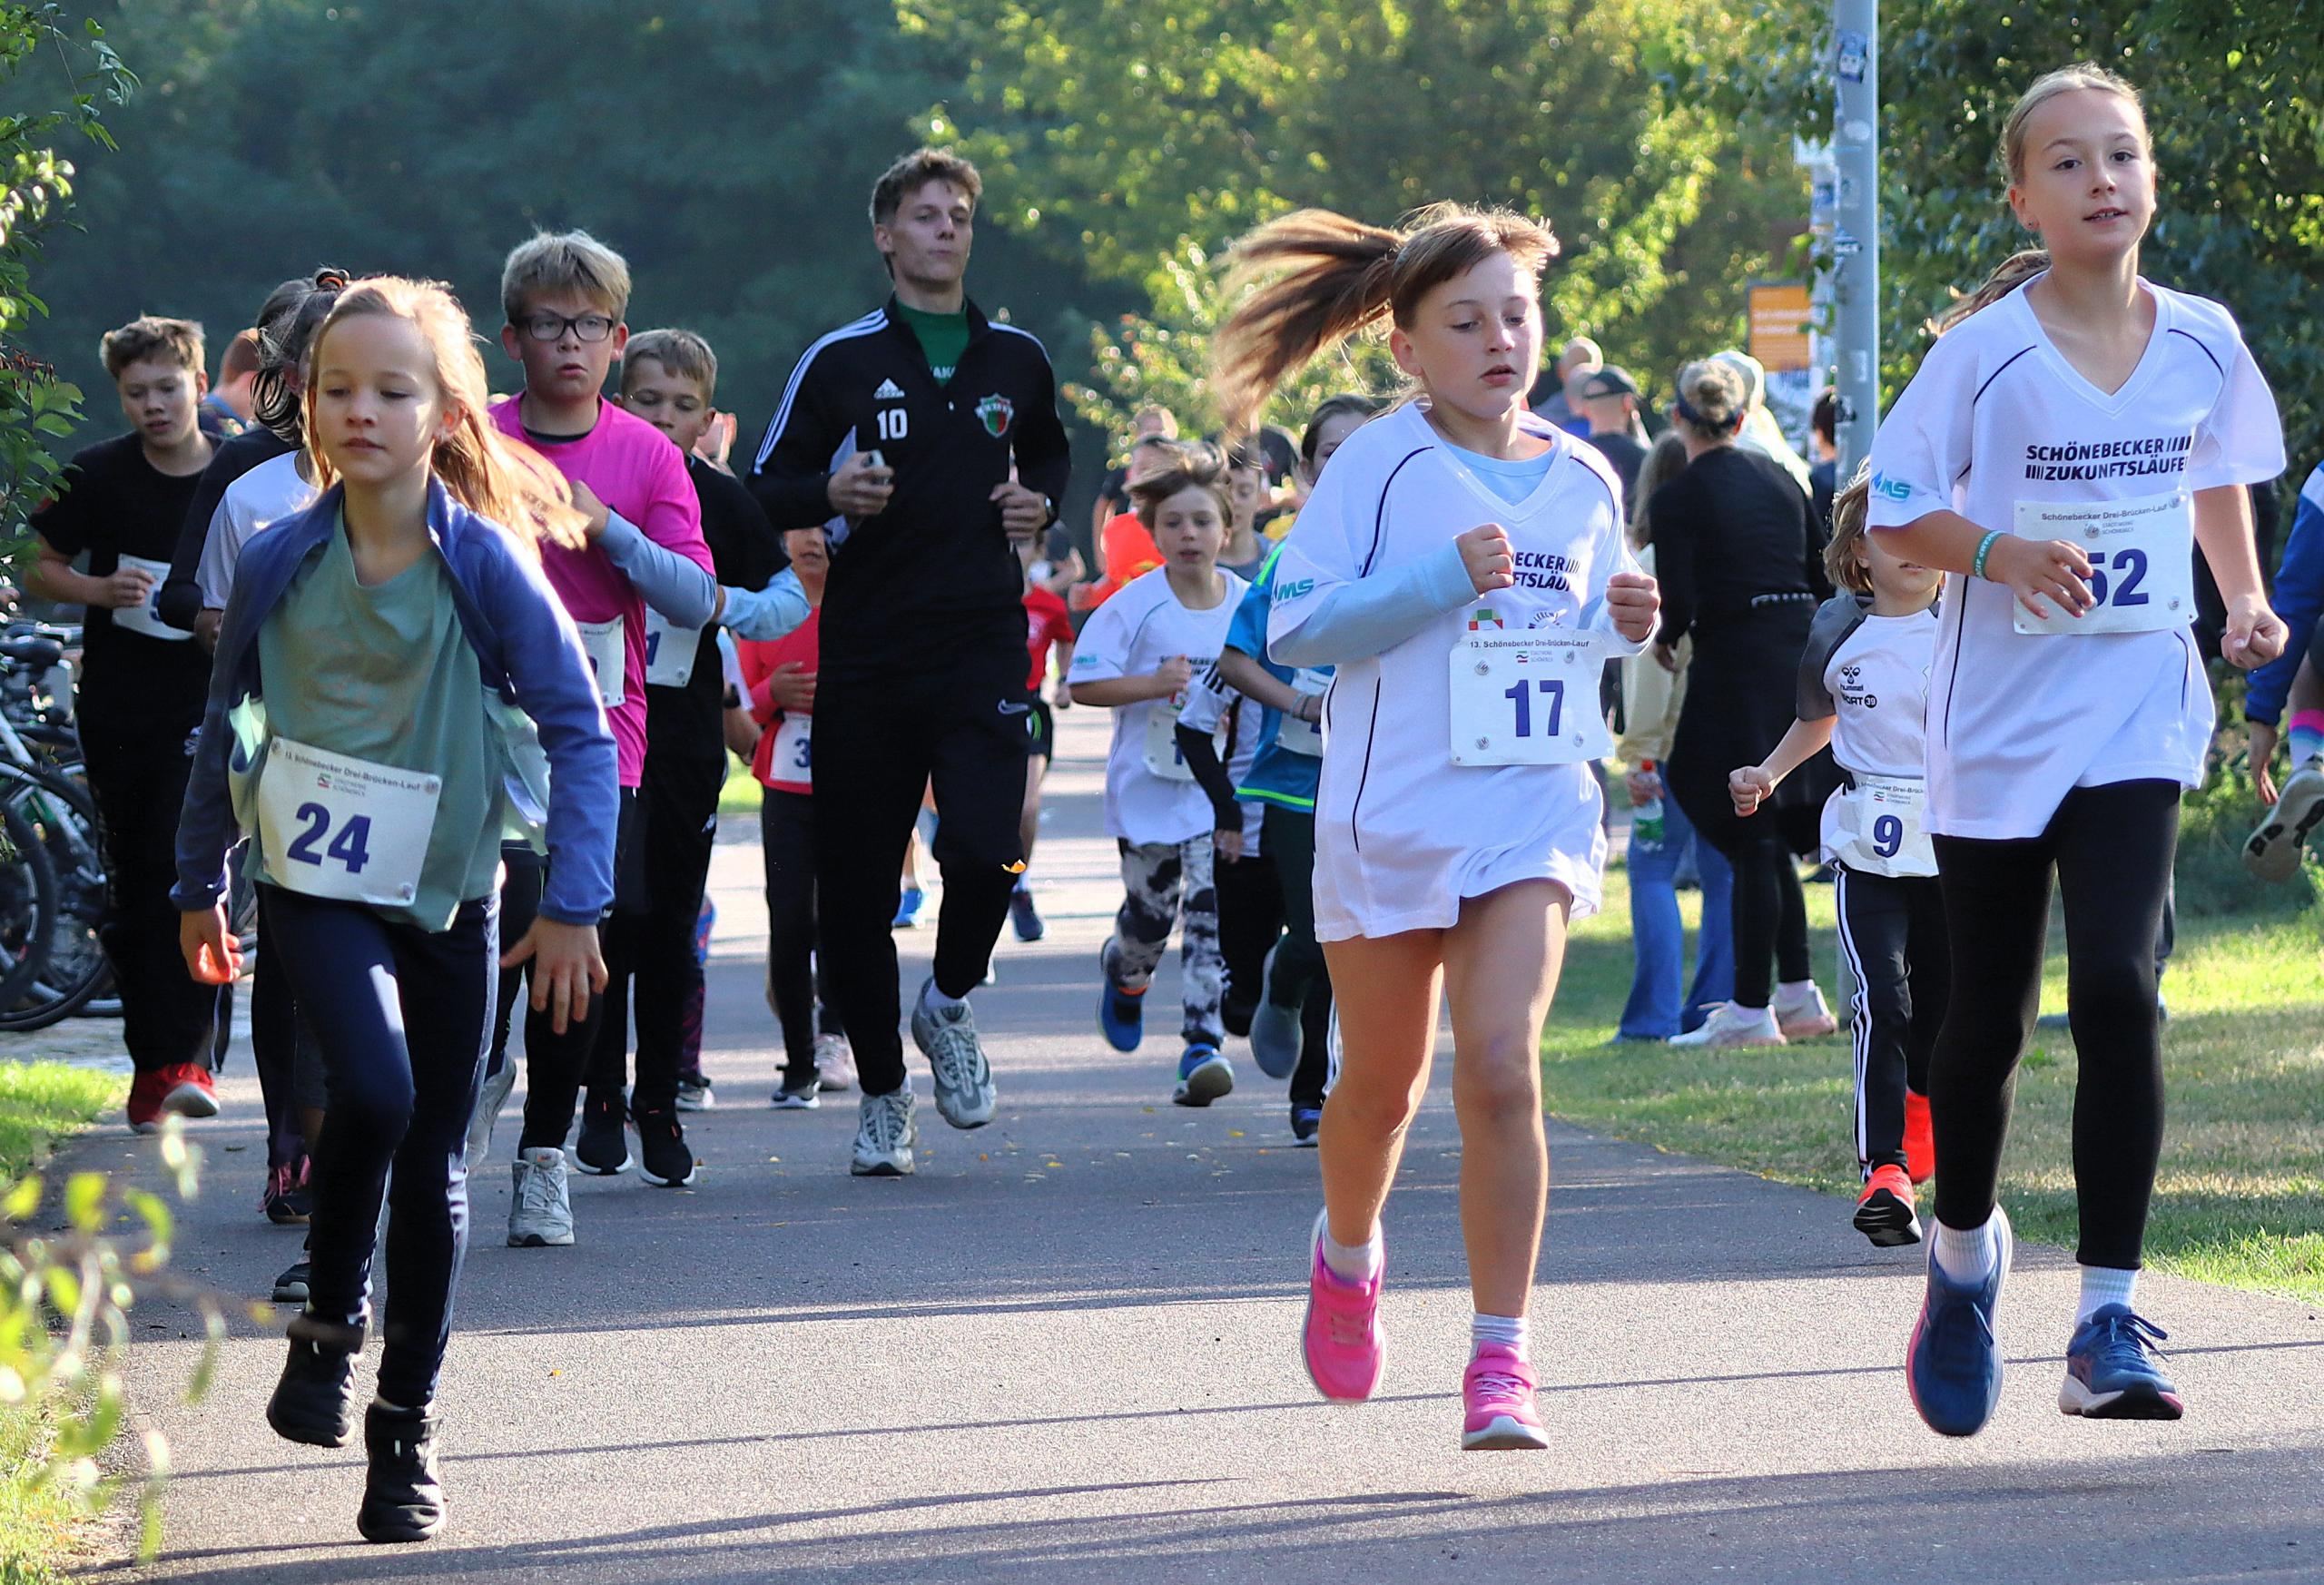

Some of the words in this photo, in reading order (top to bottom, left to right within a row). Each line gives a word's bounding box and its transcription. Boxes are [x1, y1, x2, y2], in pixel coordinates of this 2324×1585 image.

[877, 408, 908, 440] 10
[2025, 438, 2164, 461] SCHÖNEBECKER
[2043, 455, 2188, 480] ZUKUNFTSLÄUFE
[2042, 512, 2101, 521] Schönebecker
[2102, 503, 2167, 518] Drei-Brücken-Lauf
[1512, 551, 1565, 571] ECKER
[1512, 570, 1570, 592] FTSLÄU
[1483, 639, 1534, 648] Schönebecker
[1535, 639, 1590, 647] Drei-Brücken-Lauf
[1840, 683, 1863, 691] hummel
[1505, 679, 1564, 737] 17
[287, 802, 371, 873] 24
[1873, 814, 1903, 858] 9
